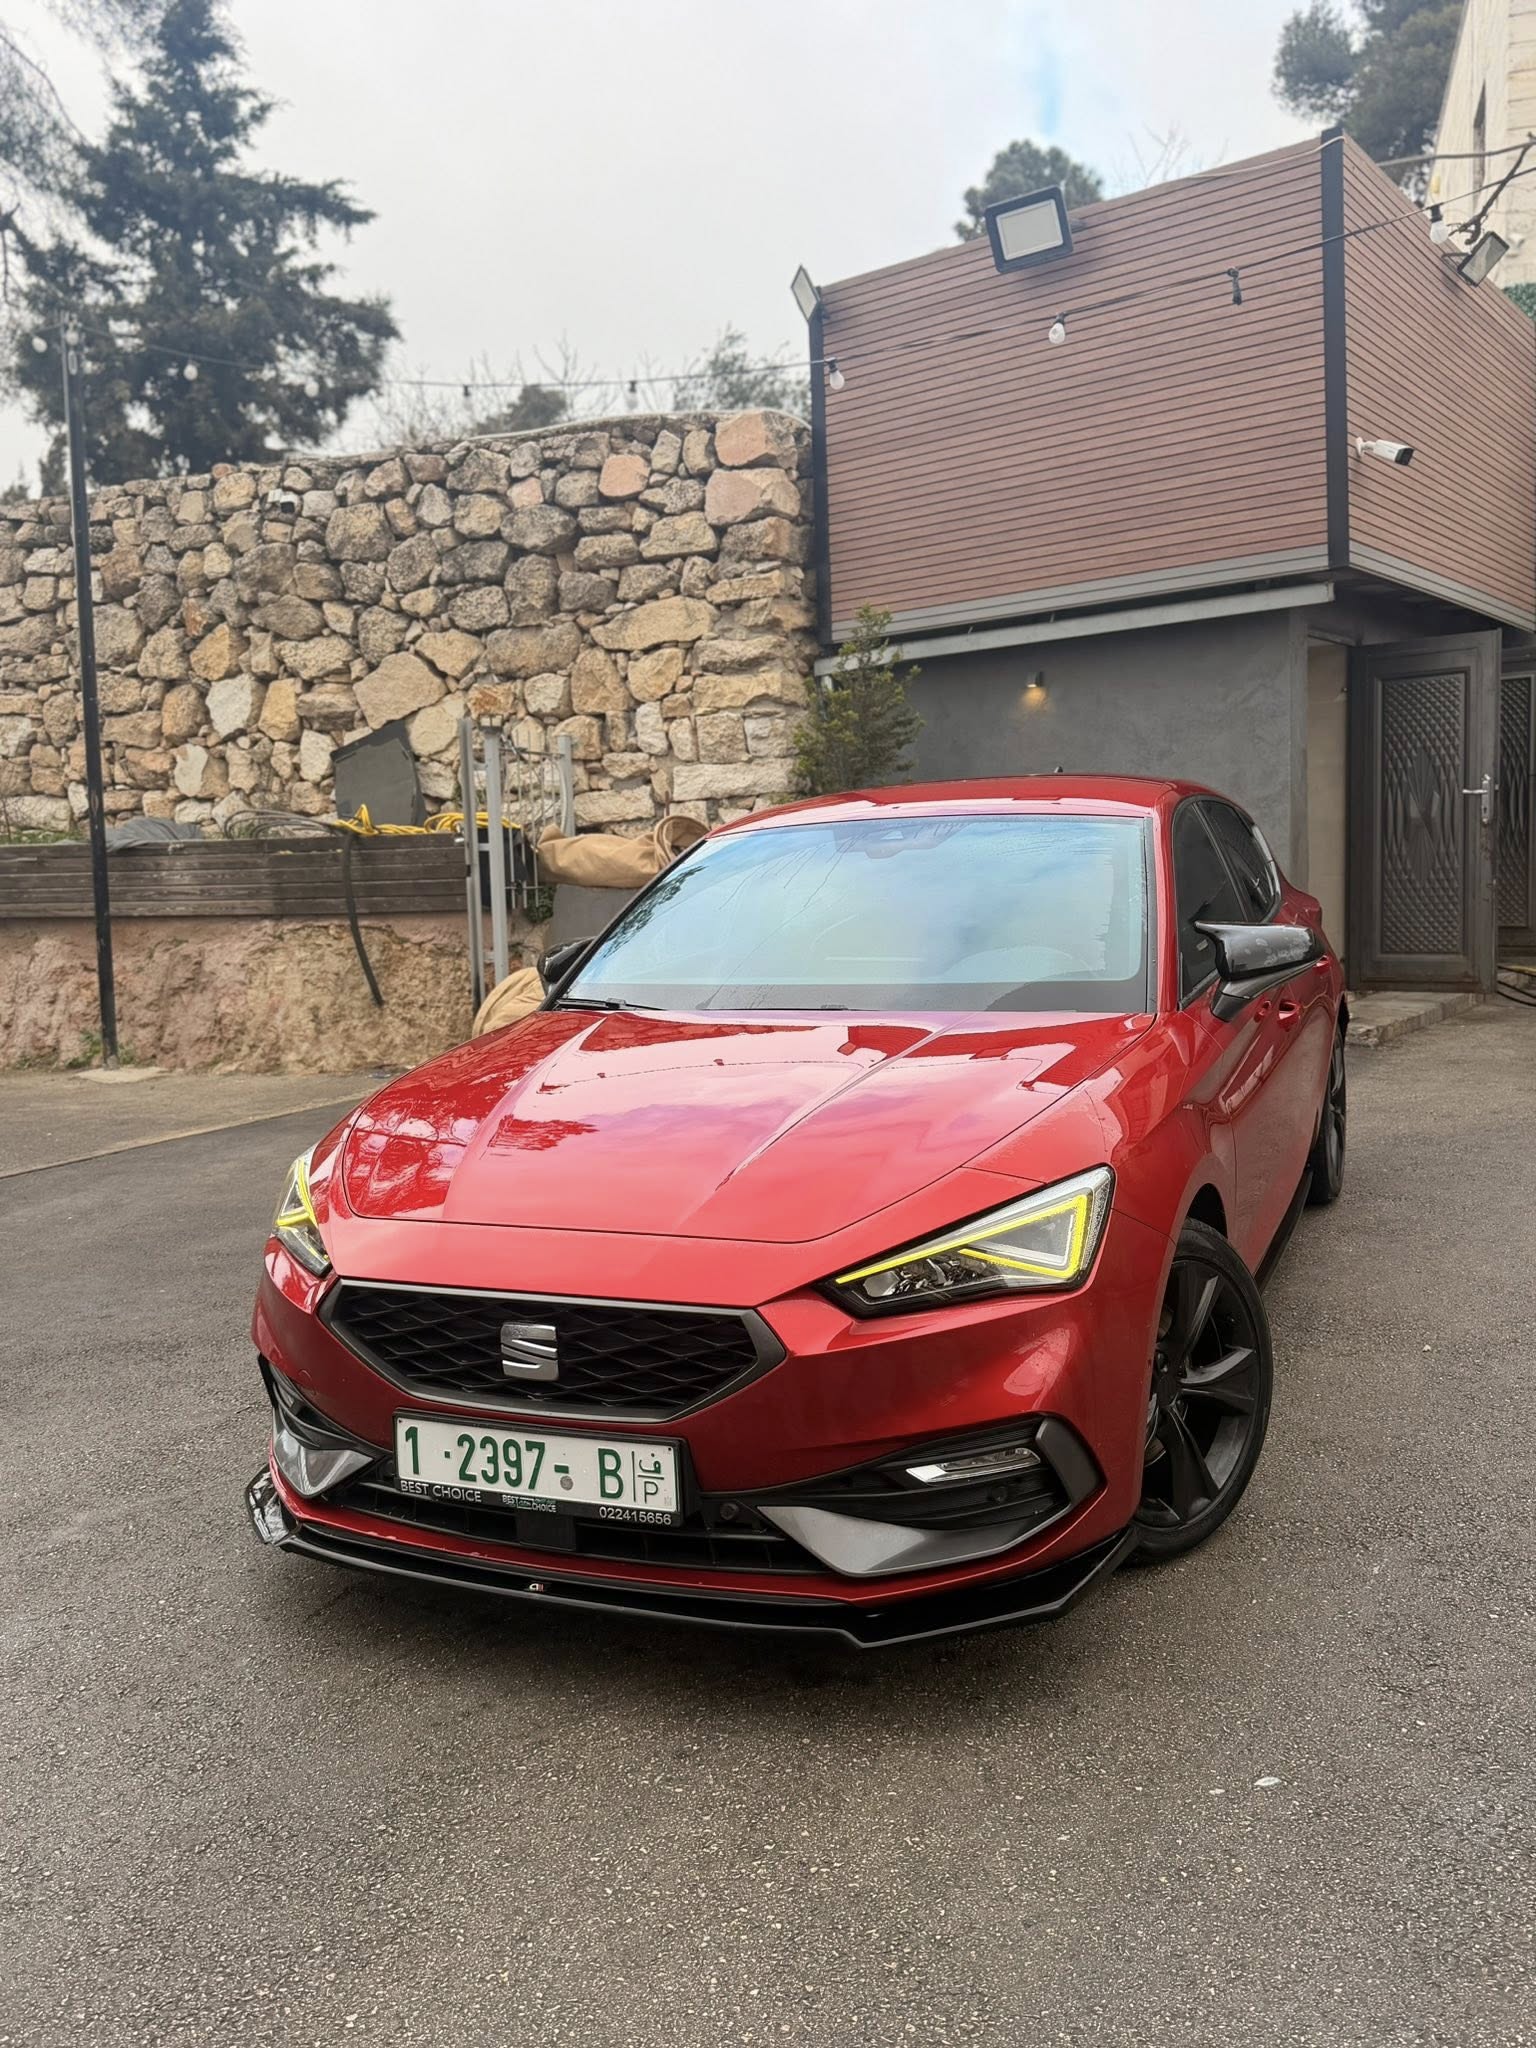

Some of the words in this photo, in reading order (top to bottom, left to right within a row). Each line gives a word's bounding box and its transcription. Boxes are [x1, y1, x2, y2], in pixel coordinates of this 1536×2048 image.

[400, 1480, 429, 1495] BEST
[432, 1485, 482, 1503] CHOICE
[502, 1494, 519, 1505] BEST
[643, 1480, 659, 1504] P
[532, 1502, 557, 1513] CHOICE
[599, 1506, 672, 1525] 022415656
